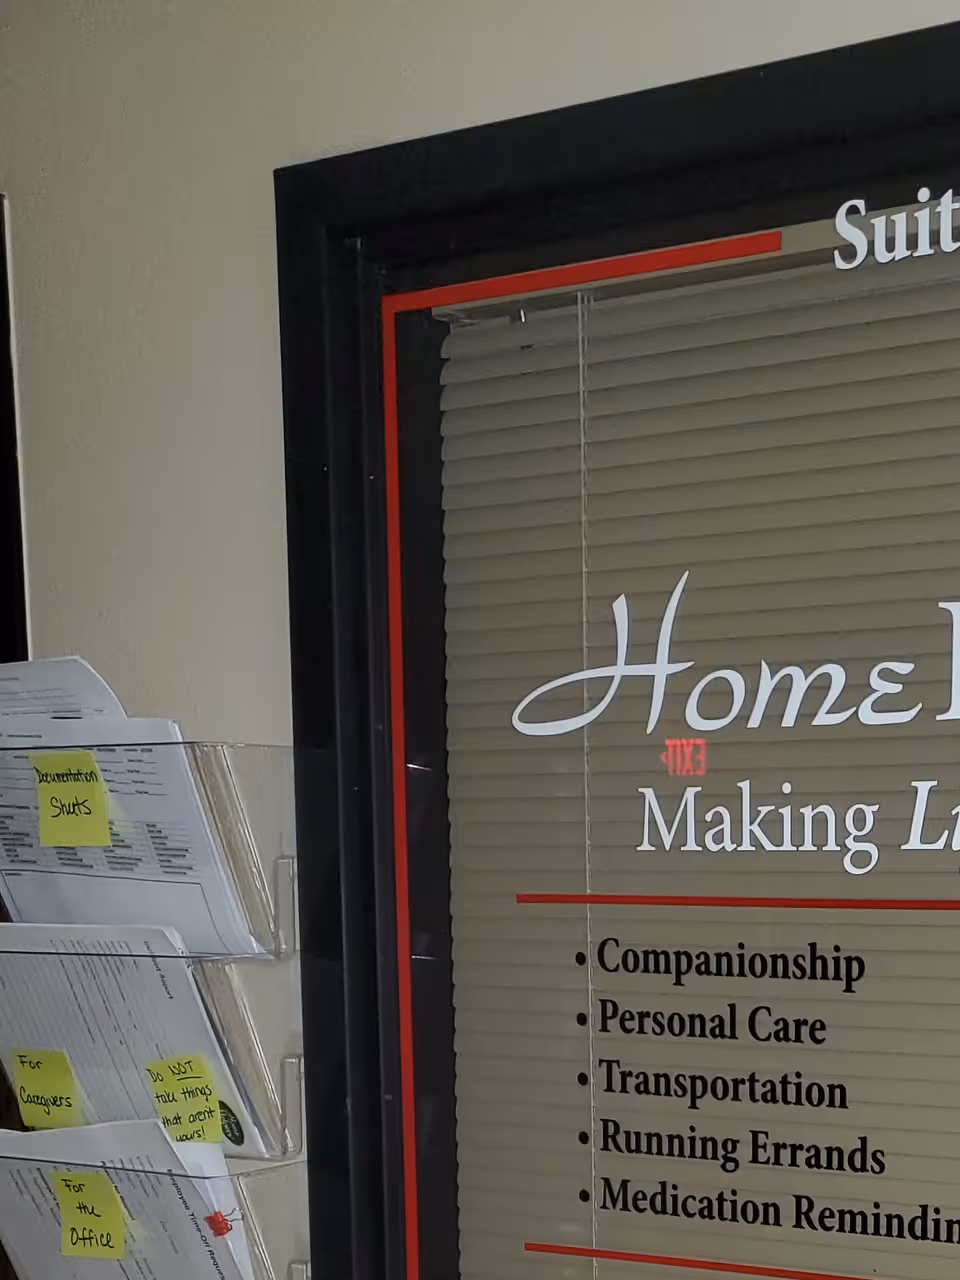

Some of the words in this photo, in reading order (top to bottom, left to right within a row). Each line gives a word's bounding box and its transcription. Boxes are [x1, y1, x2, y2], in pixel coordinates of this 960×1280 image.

[511, 570, 923, 736] Home
[33, 766, 98, 784] Documentation
[635, 779, 879, 875] Making
[596, 937, 866, 993] Companionship
[598, 998, 739, 1041] Personal
[747, 1006, 827, 1045] Care
[17, 1054, 43, 1070] For
[145, 1068, 164, 1083] Do
[168, 1060, 193, 1076] NOT
[180, 1085, 212, 1103] things
[599, 1058, 850, 1110] Transportation
[19, 1086, 72, 1116] Caregivers
[162, 1113, 182, 1129] that
[175, 1125, 206, 1142] yours!
[600, 1118, 740, 1173] Running
[748, 1129, 886, 1175] Errands
[60, 1178, 86, 1193] For
[75, 1201, 102, 1218] the
[600, 1177, 782, 1228] Medication
[69, 1226, 115, 1249] Office
